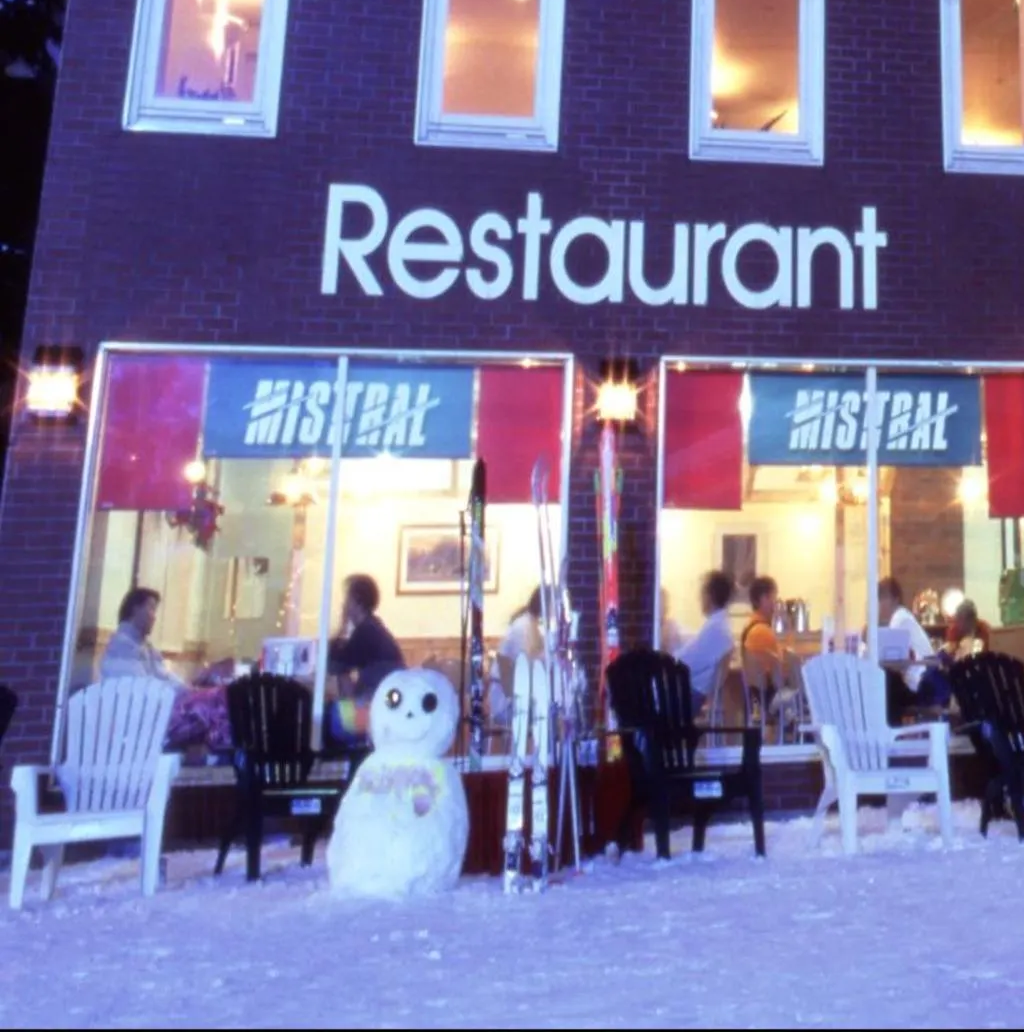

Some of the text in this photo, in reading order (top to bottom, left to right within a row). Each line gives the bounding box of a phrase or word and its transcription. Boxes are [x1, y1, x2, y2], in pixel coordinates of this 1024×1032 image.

[321, 183, 887, 310] Restaurant
[243, 379, 439, 446] MISTRAL
[787, 389, 957, 450] MISTRAL
